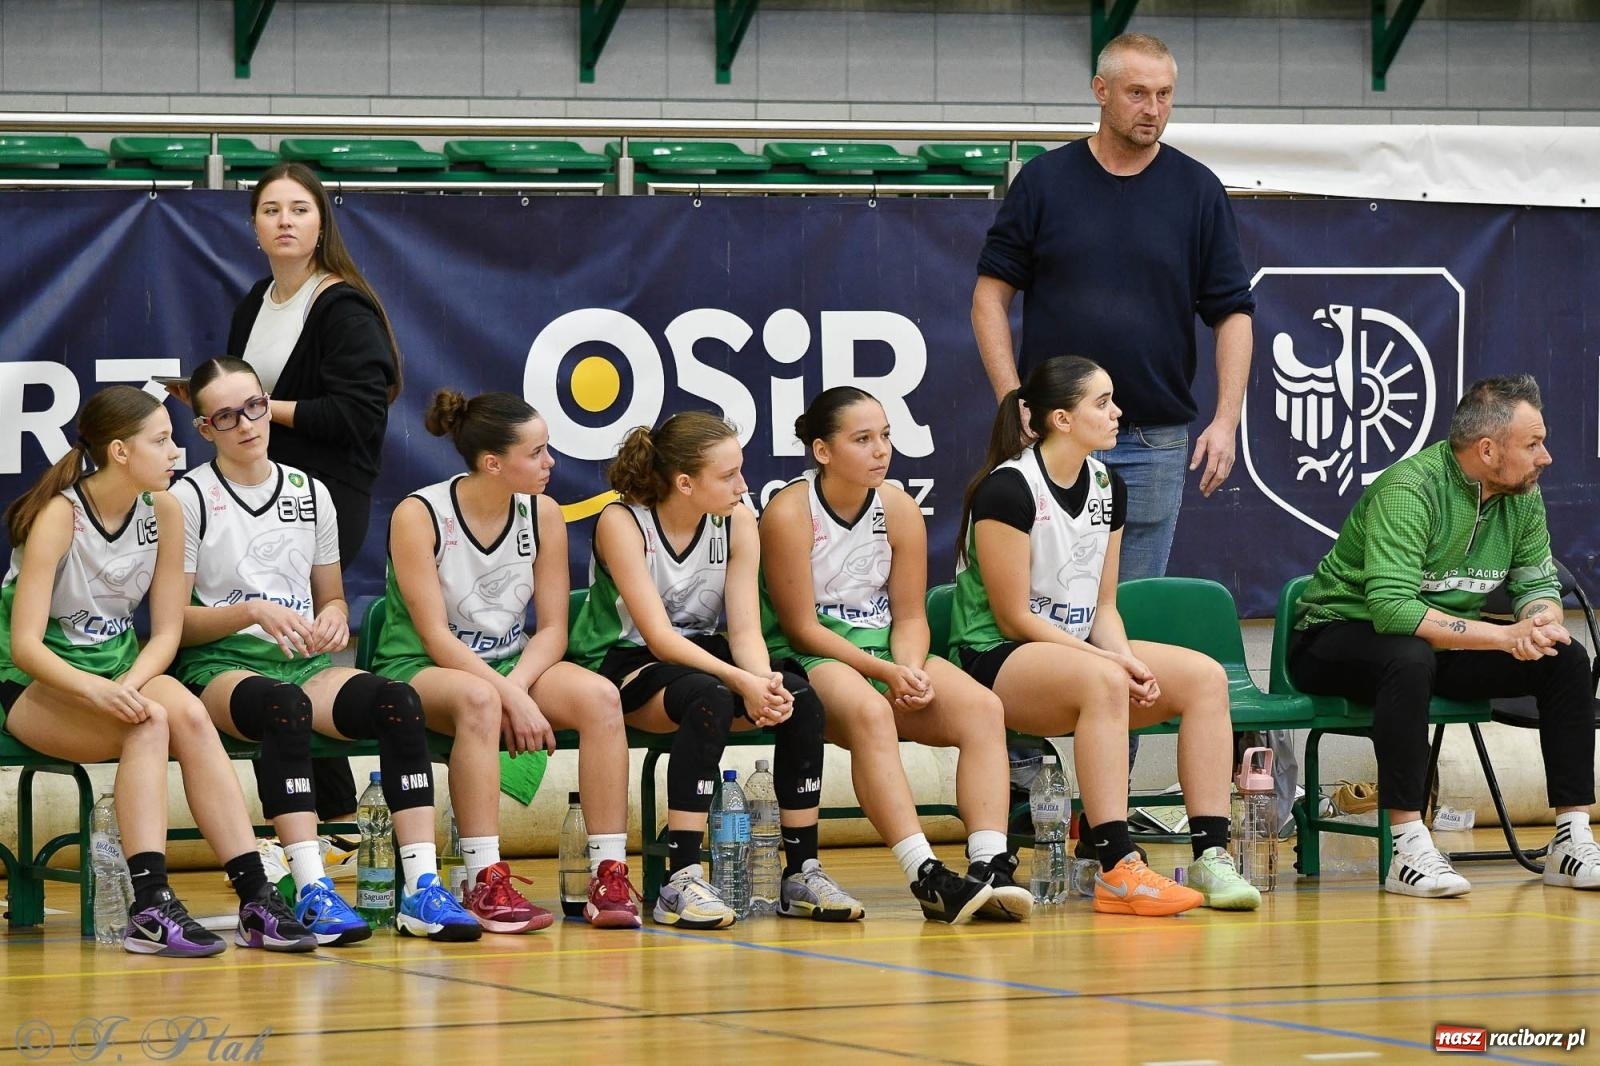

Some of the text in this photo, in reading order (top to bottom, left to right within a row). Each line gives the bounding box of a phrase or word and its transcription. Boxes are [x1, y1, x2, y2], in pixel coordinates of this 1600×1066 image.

[523, 308, 936, 461] OSiR
[1088, 498, 1112, 526] 25
[294, 777, 311, 793] NBA
[410, 773, 429, 789] NBA
[363, 892, 390, 902] Saguaro
